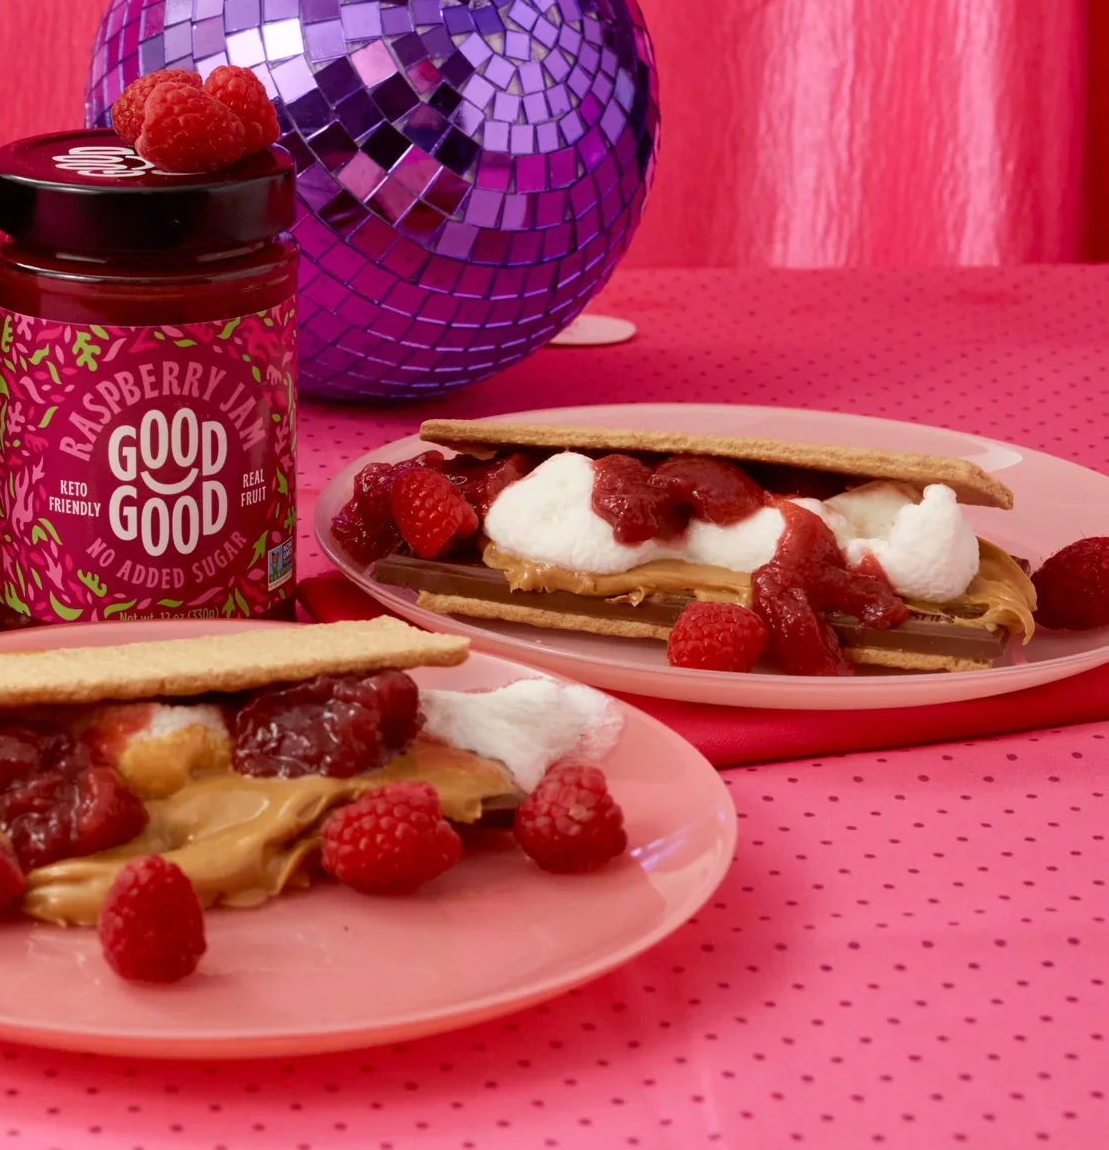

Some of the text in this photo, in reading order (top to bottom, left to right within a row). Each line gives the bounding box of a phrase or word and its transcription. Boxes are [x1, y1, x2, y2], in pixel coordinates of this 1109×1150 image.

[59, 360, 266, 462] RASPBERRY JAM
[108, 407, 227, 482] GOOD
[60, 480, 88, 497] KETO
[241, 486, 266, 507] FRUIT
[243, 469, 265, 489] REAL
[49, 496, 101, 517] FRIENDLY
[109, 480, 228, 557] GOOD
[87, 537, 116, 567] NO
[116, 559, 185, 589] ADDED
[192, 531, 248, 583] SUGAR
